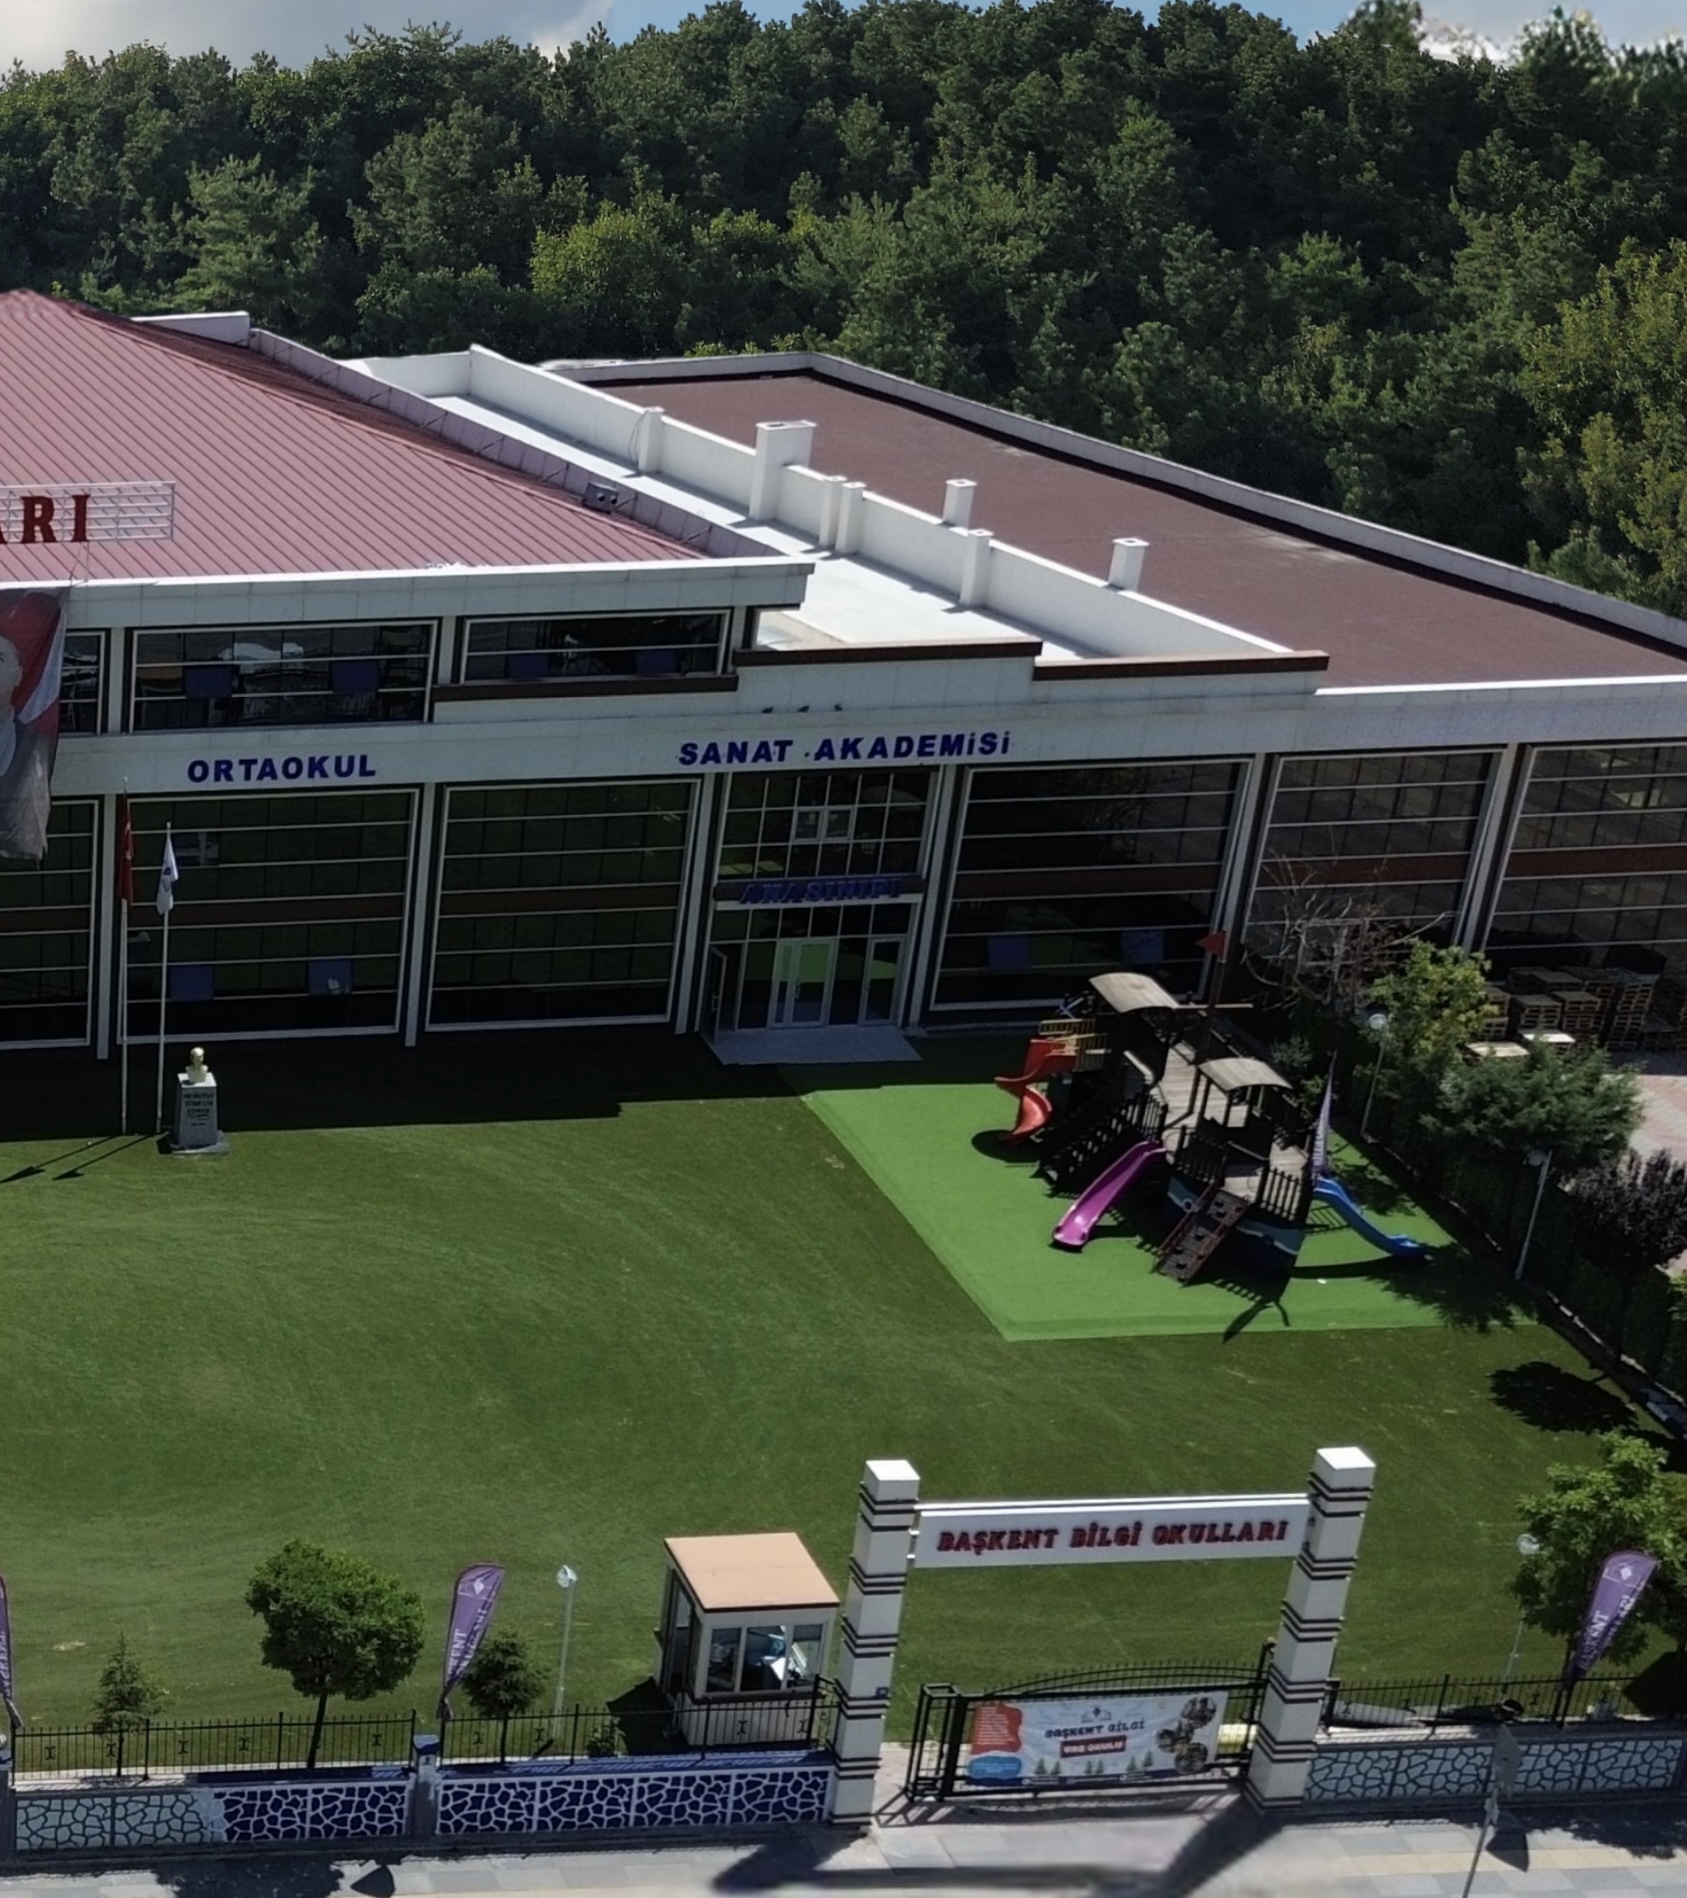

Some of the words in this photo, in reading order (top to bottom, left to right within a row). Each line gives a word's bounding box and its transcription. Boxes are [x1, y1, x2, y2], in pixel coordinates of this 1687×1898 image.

[679, 739, 794, 766] SANAT
[813, 730, 1011, 763] AKADEMİSİ
[187, 754, 377, 783] ORTAOKUL
[739, 879, 904, 905] ANASINIFI
[936, 1527, 1060, 1556] BAŞKENT
[1070, 1520, 1143, 1548] BİLGİ
[1152, 1520, 1290, 1545] OKULLARI
